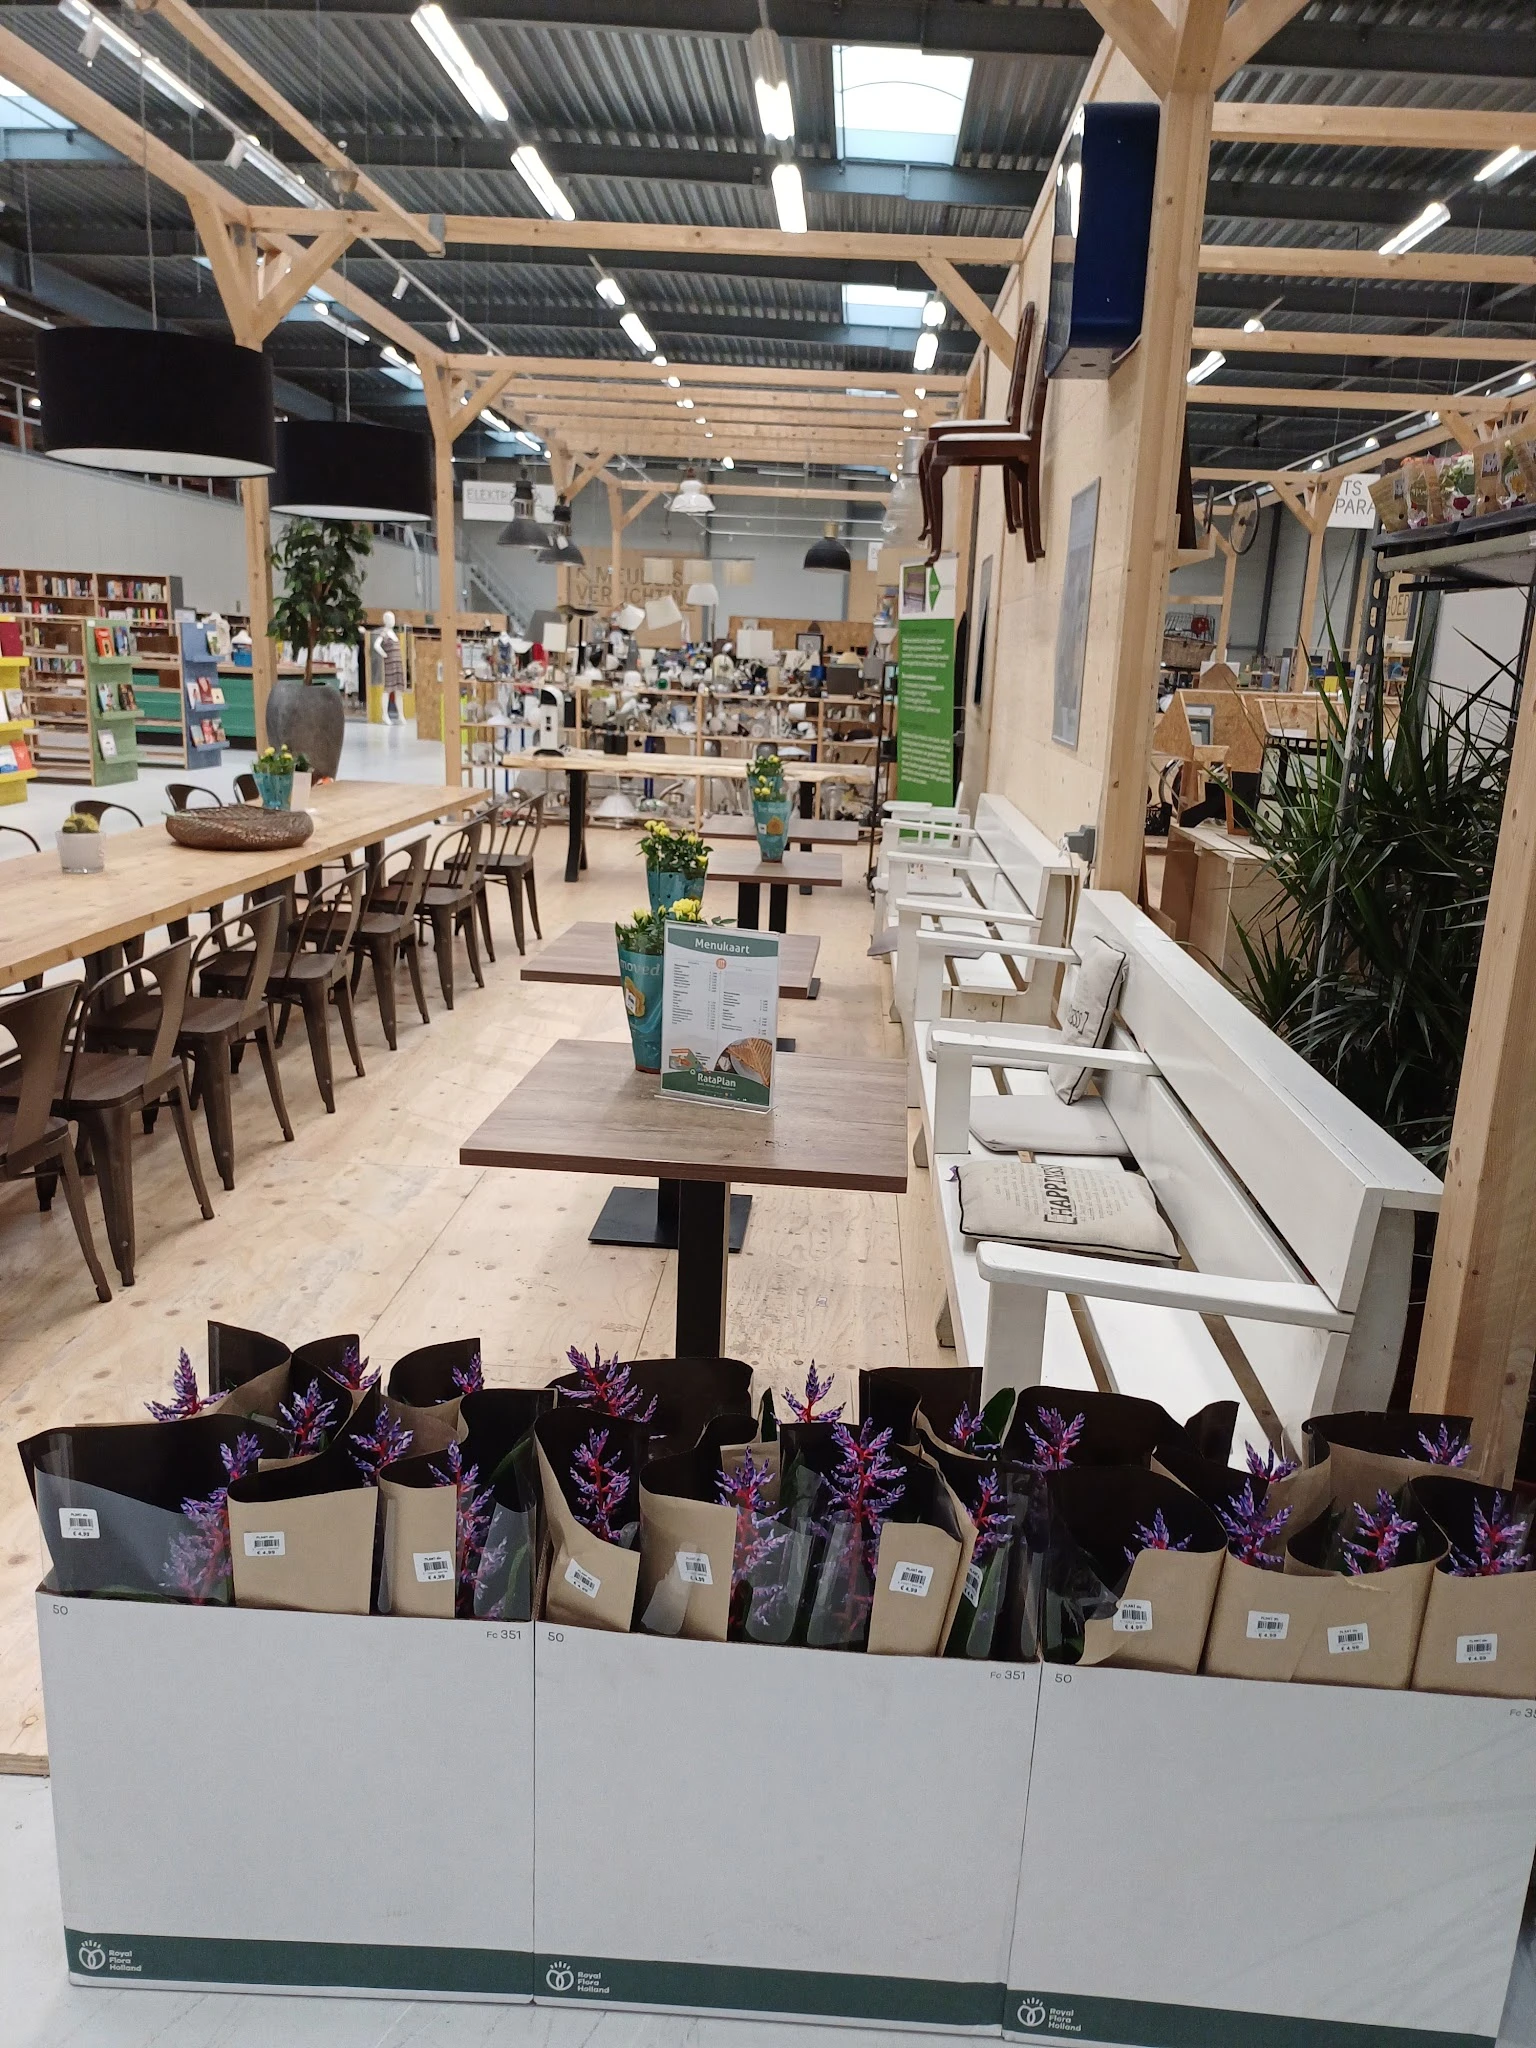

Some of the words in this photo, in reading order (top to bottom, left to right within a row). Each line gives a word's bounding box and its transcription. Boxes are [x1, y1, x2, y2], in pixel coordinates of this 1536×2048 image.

[695, 938, 750, 954] Menukaart
[697, 1073, 736, 1087] RataPlan
[53, 1604, 68, 1615] 50
[486, 1631, 498, 1639] Fc
[500, 1629, 521, 1640] 351
[547, 1631, 564, 1642] 50
[1004, 1670, 1025, 1680] 351
[1055, 1673, 1072, 1683] 50
[577, 1971, 601, 1979] Royal
[577, 1978, 599, 1986] Flora
[577, 1985, 610, 1993] Holland
[1050, 2008, 1074, 2016] Royal
[1049, 2014, 1071, 2023] Flora
[1048, 2021, 1082, 2031] Holland
